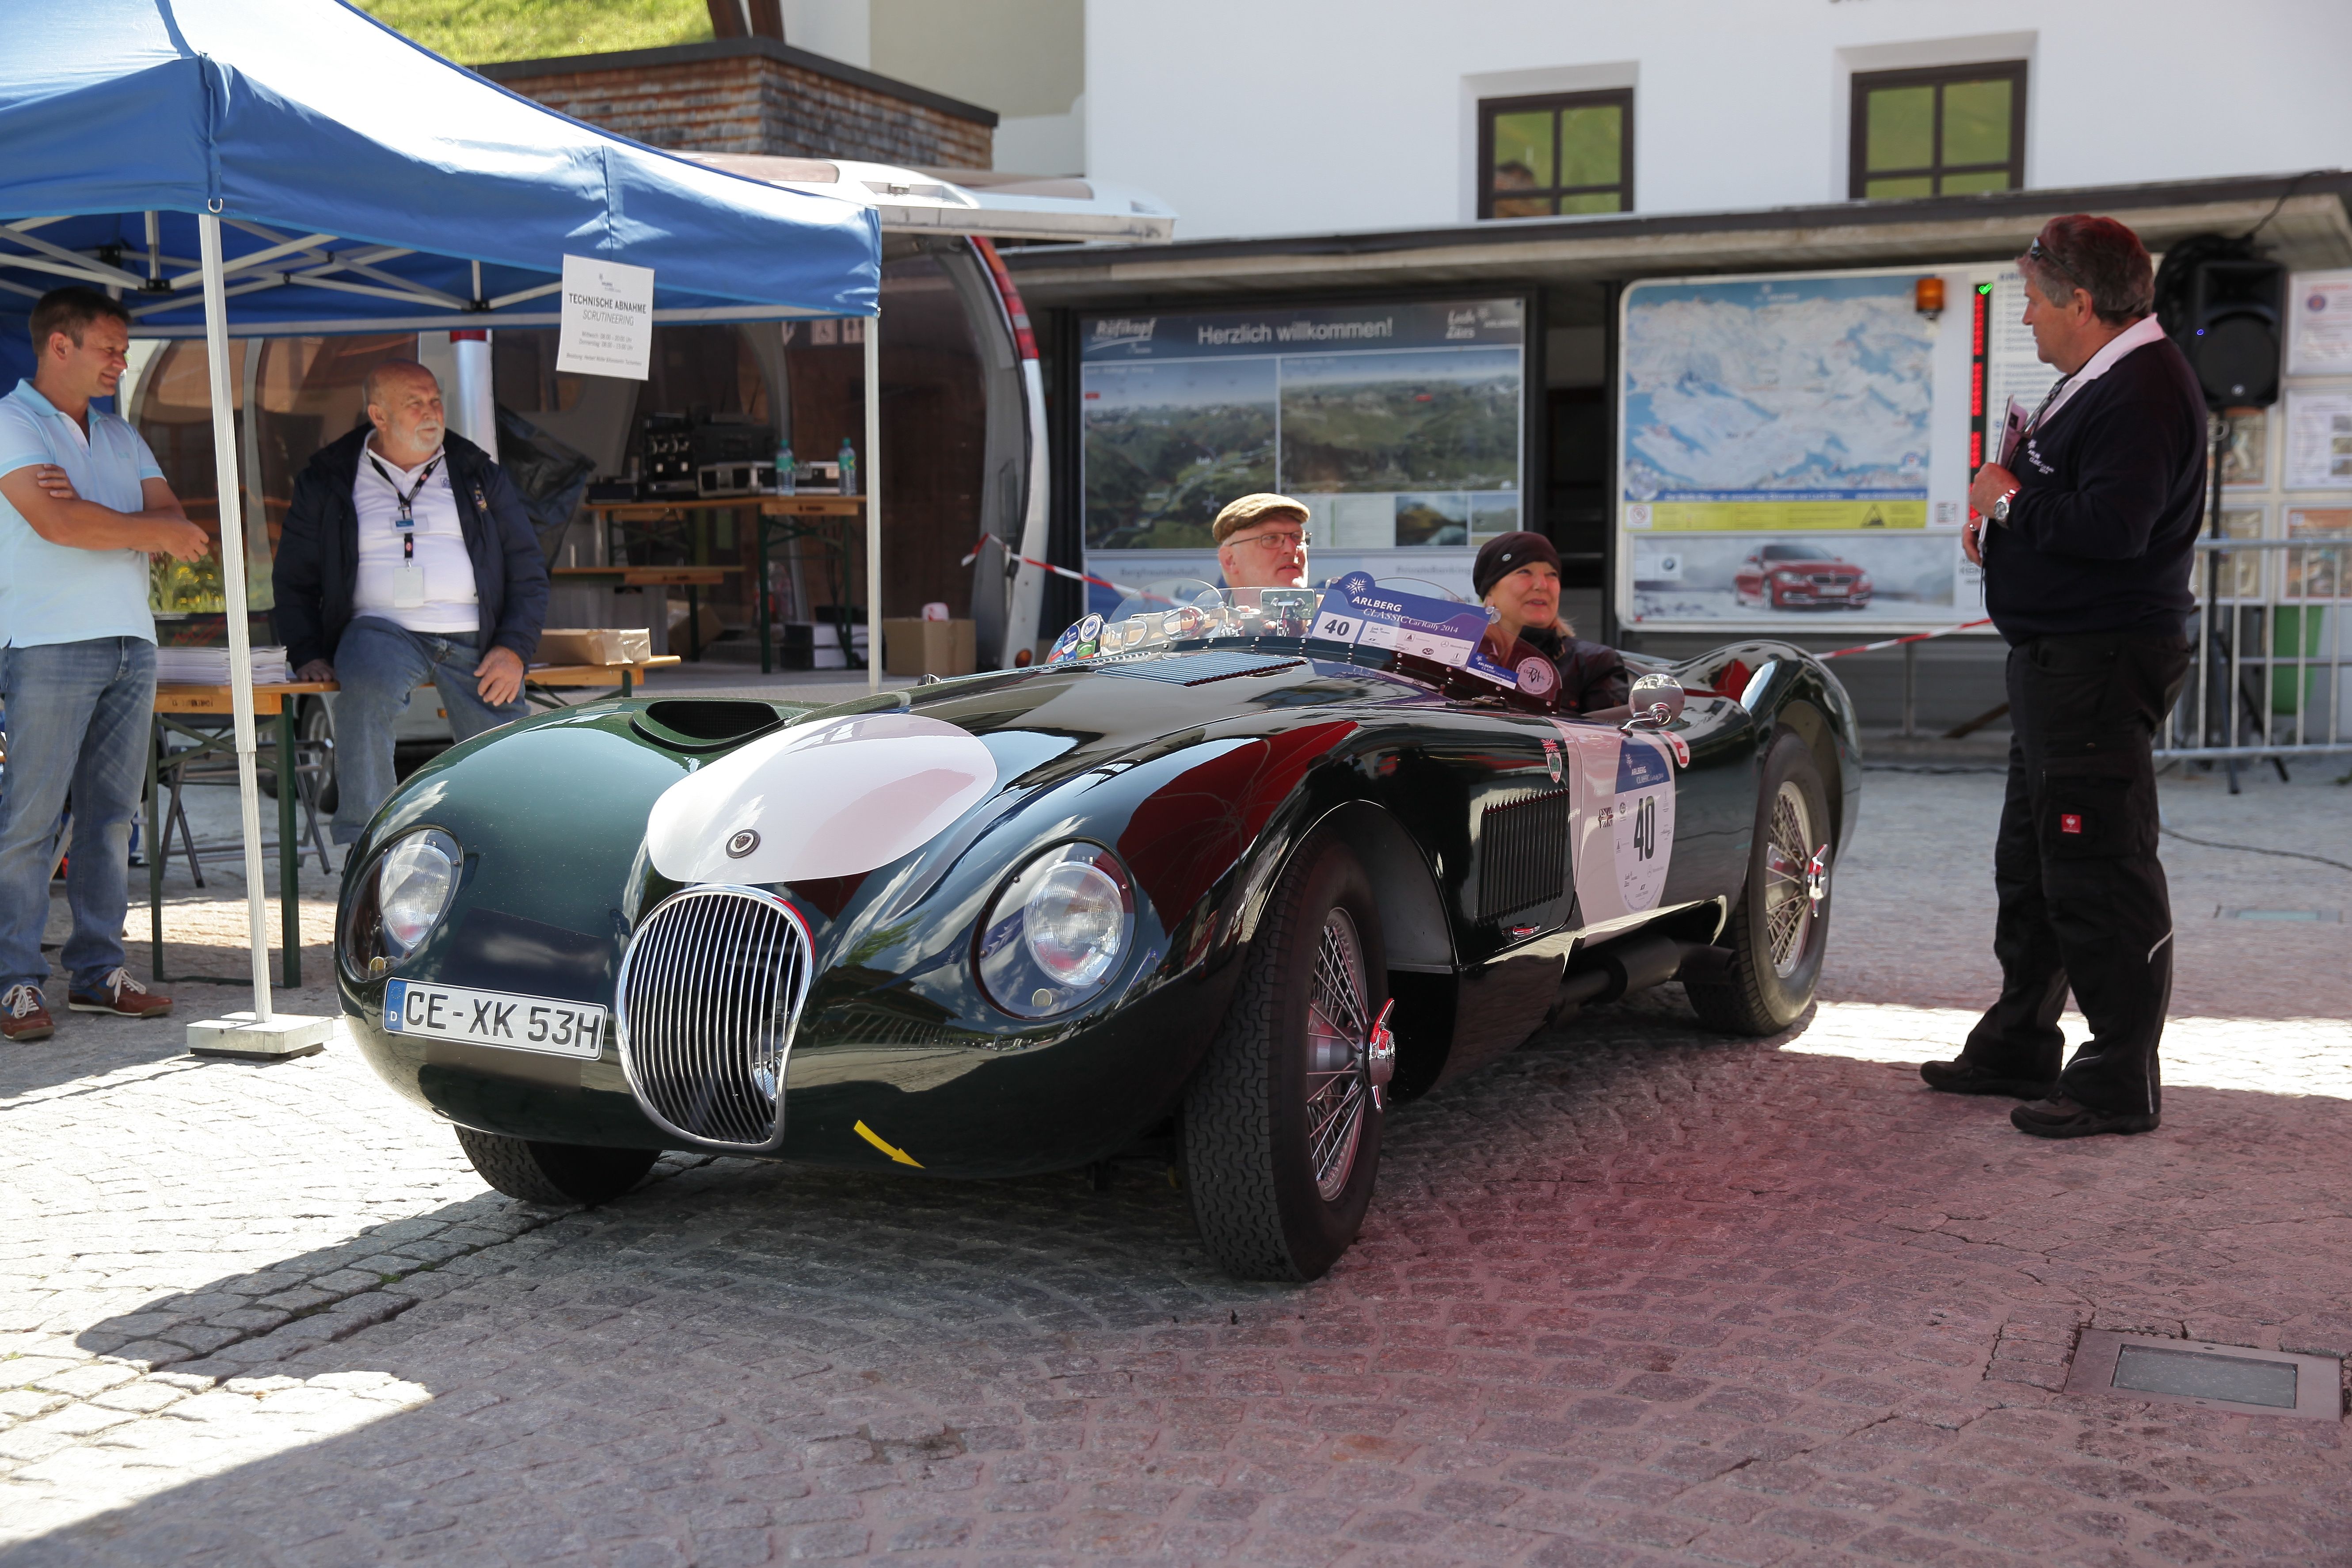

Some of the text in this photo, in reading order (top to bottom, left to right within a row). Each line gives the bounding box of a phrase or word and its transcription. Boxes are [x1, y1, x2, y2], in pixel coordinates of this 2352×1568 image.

[568, 293, 647, 314] TECHNISCHE ABNAHME
[583, 310, 635, 326] SCRUTINEERING
[1198, 316, 1393, 345] Herzlich willkommen!
[1352, 596, 1402, 612] ARLBERG
[1324, 619, 1349, 636] 40
[1363, 608, 1409, 624] CLASSIC
[1440, 624, 1459, 633] 2014
[1633, 795, 1655, 861] 40
[390, 1010, 398, 1022] D
[405, 990, 601, 1050] CE-XK 53H
